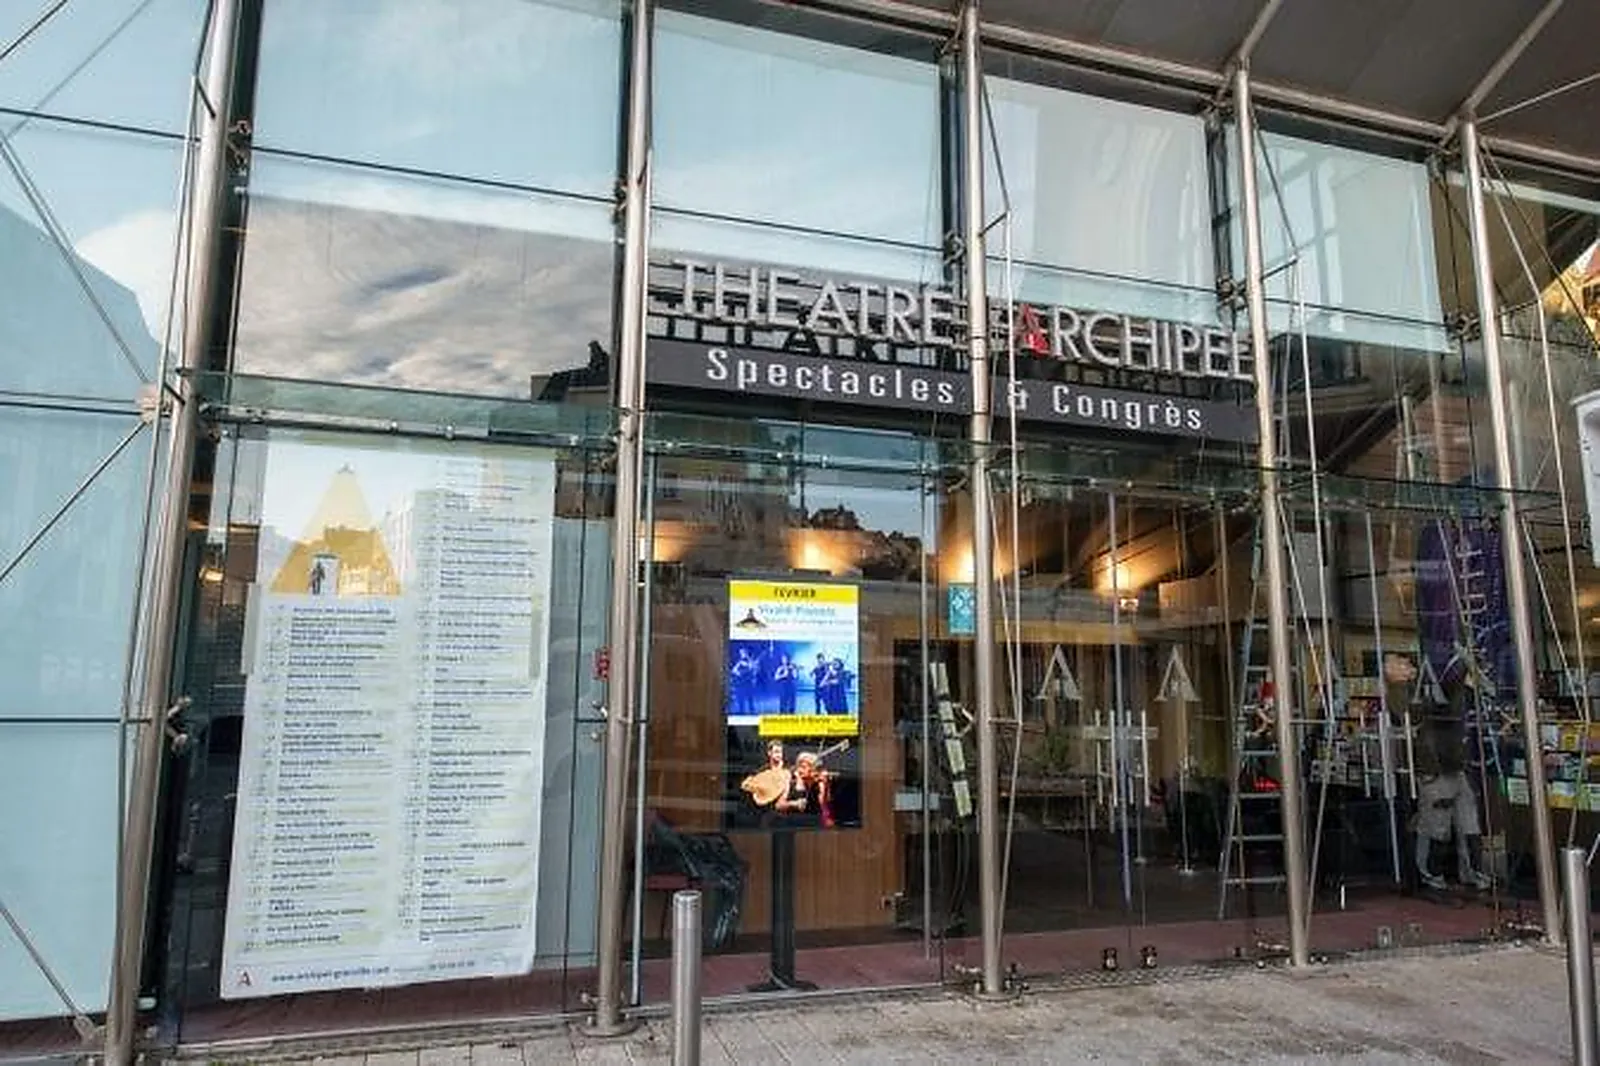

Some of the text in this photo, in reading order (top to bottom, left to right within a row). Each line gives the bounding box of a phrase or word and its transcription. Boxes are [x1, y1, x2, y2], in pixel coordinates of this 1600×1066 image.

[672, 257, 1254, 381] THEATRE ARCHIPEL
[706, 348, 955, 404] Spectacles
[1052, 384, 1202, 430] Congrès
